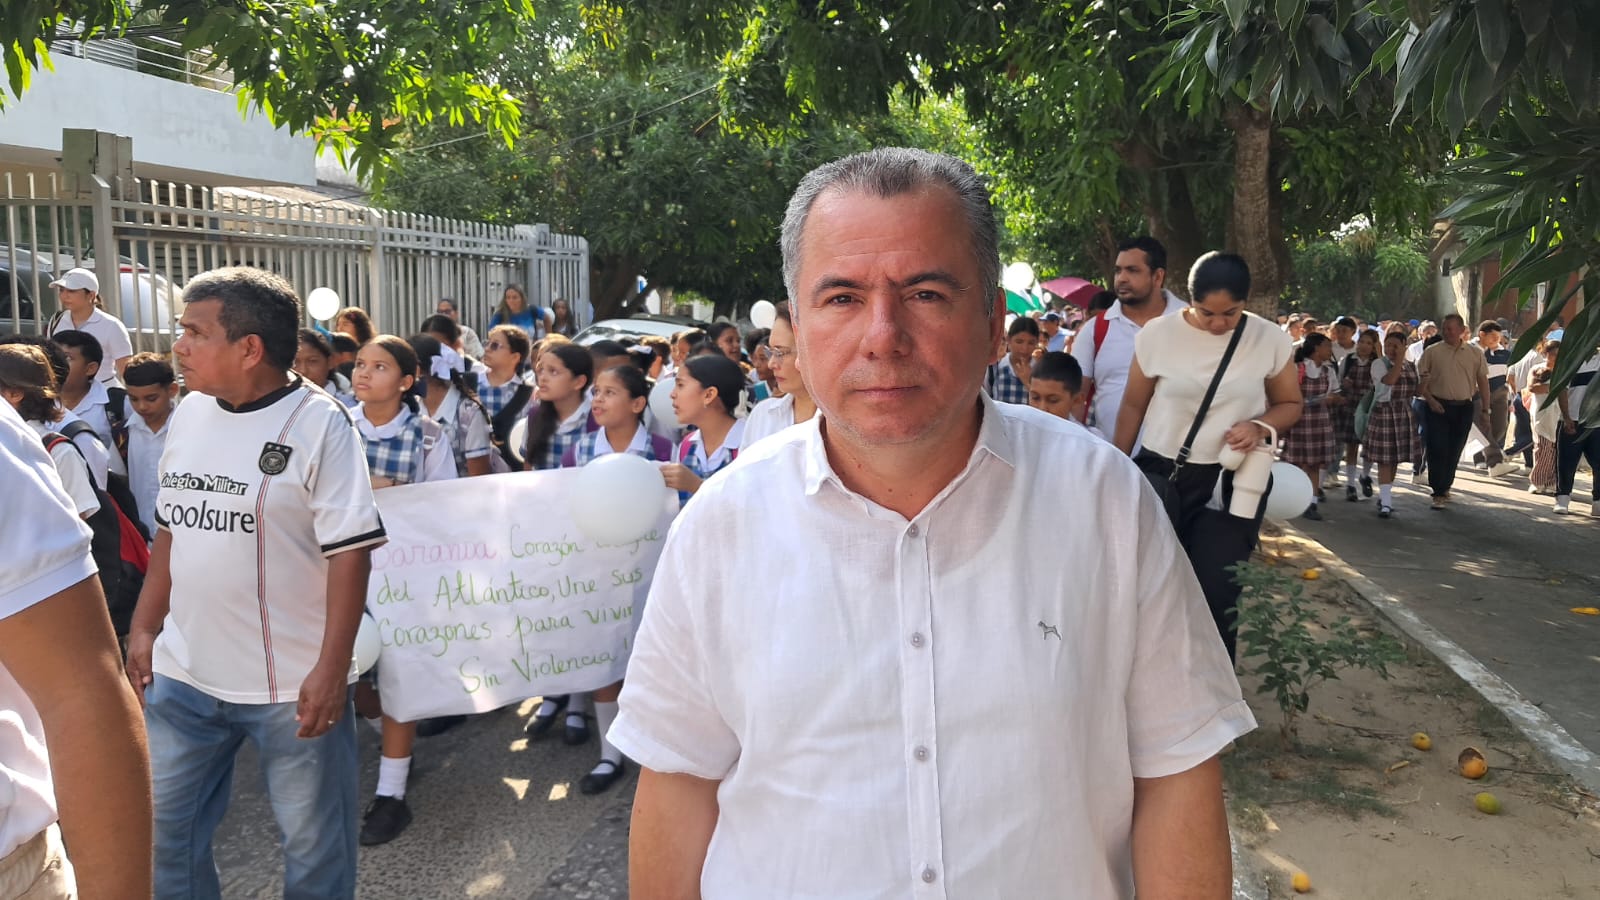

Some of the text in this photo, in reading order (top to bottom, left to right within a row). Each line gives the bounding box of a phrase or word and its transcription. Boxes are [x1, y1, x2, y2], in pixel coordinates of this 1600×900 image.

[160, 472, 249, 495] olegio Militar
[164, 499, 255, 533] coolsure
[510, 523, 585, 566] Corazón
[376, 572, 414, 605] del
[377, 617, 493, 658] Corazones
[458, 655, 501, 694] Sin
